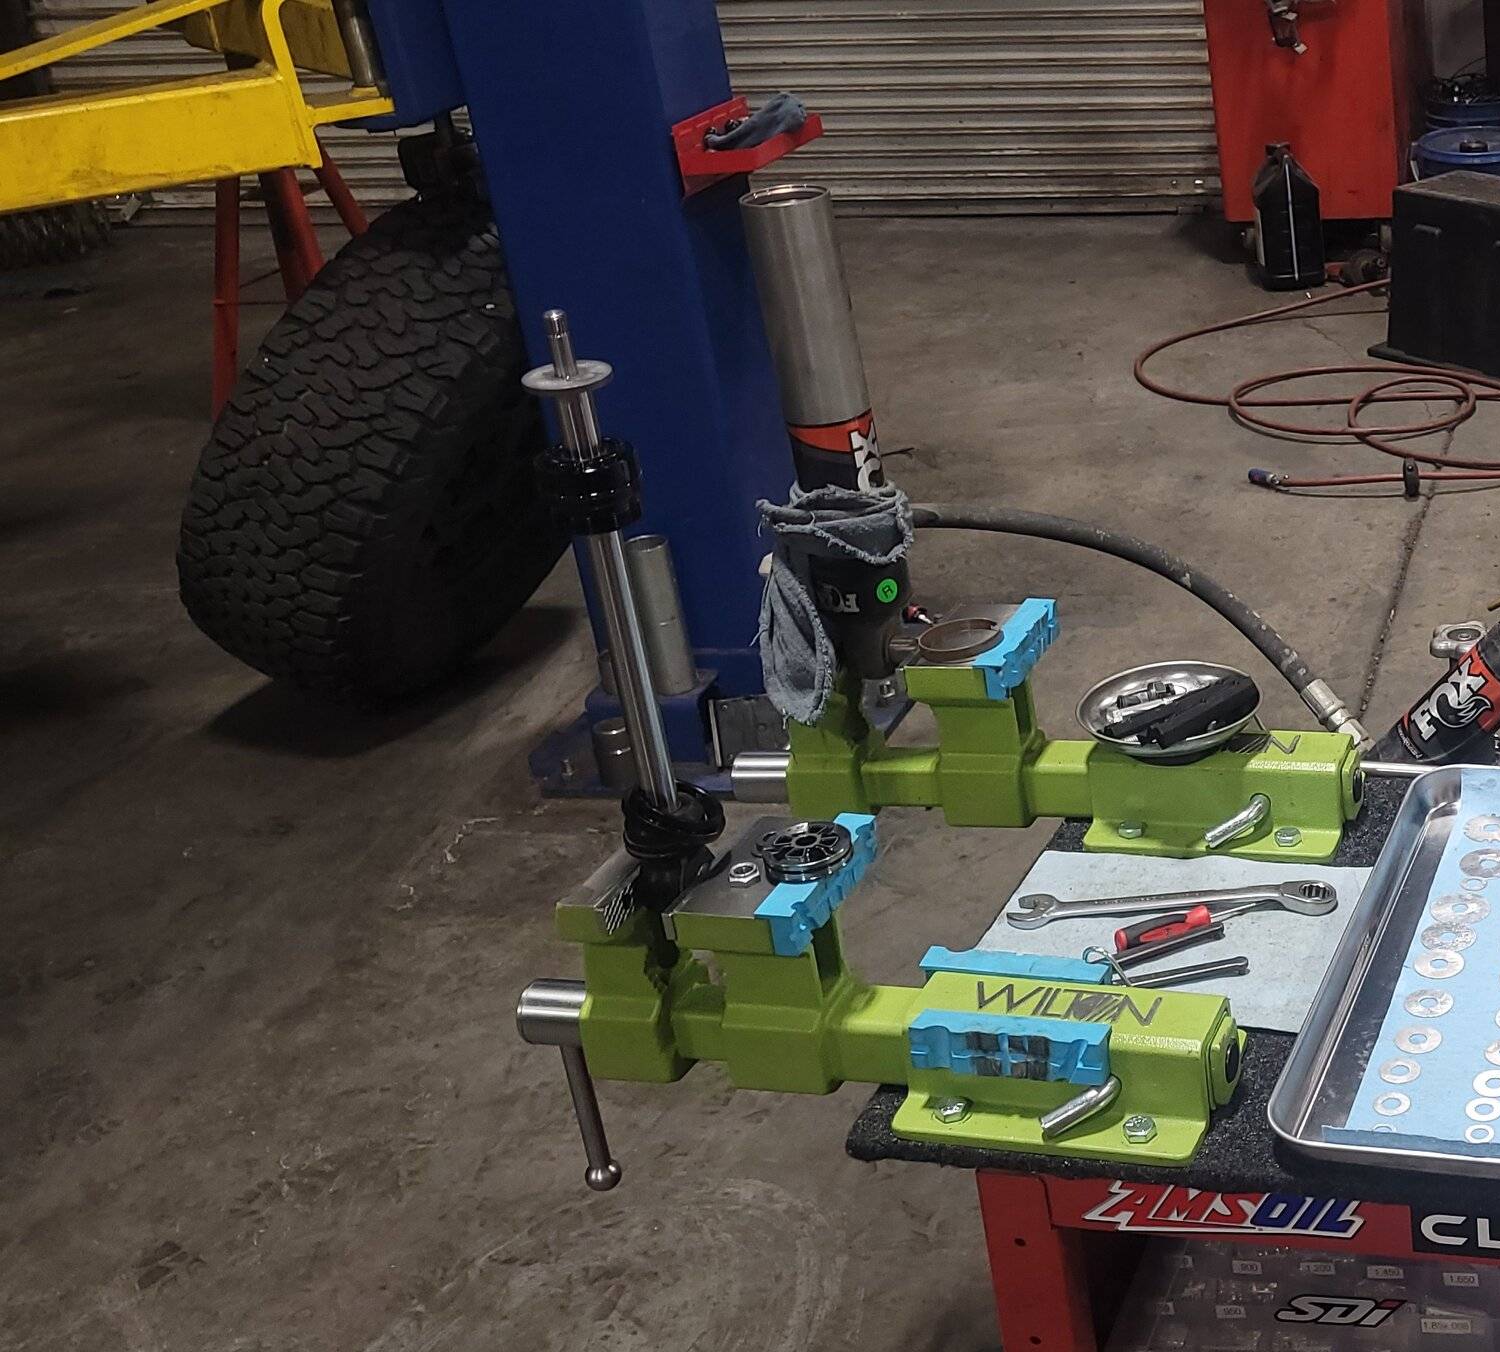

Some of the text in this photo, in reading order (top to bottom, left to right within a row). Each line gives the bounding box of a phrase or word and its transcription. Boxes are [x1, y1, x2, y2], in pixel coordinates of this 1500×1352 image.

[850, 420, 887, 494] OX
[1411, 656, 1492, 742] FOX
[977, 980, 1163, 1026] WILTON
[1086, 1182, 1363, 1237] AMSOIL
[1278, 1296, 1404, 1326] SDi
